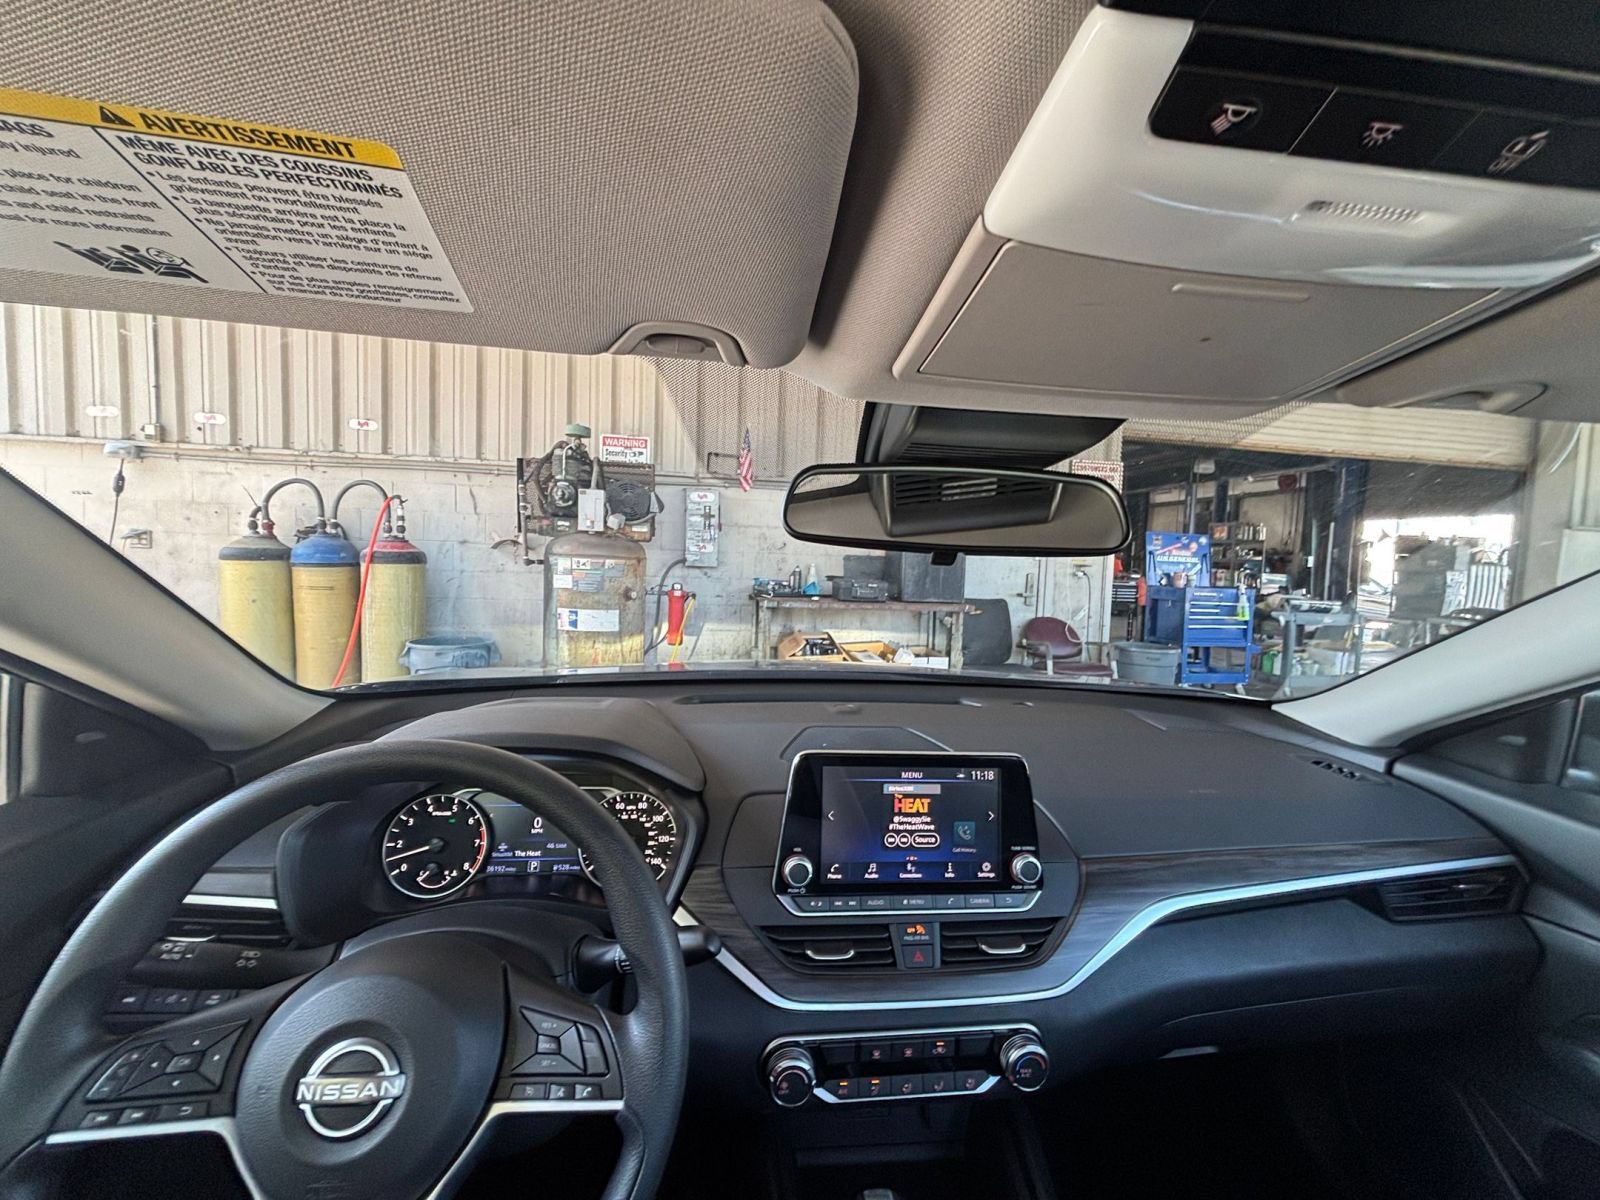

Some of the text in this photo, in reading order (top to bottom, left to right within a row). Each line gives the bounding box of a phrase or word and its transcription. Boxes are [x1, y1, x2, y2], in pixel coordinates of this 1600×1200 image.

[0, 118, 54, 138] AGS
[139, 113, 356, 158] AVERTISSEMENT
[20, 141, 82, 159] injured
[115, 135, 374, 182] MÊME AVEC DES COUSSINS
[133, 152, 403, 198] GONFLABLES PERFECTIONNÉS
[76, 177, 142, 193] children
[159, 171, 383, 209] Les enfants peuvent être blessés
[96, 194, 122, 205] the
[122, 197, 162, 210] front
[169, 184, 360, 216] grièvement ou mortellement
[84, 208, 155, 223] restraints
[193, 207, 396, 238] plus sécuritaire pour les enfants
[201, 199, 272, 215] banquette
[273, 207, 318, 220] arrière
[320, 212, 344, 223] est
[344, 214, 356, 225] la
[357, 218, 392, 230] place
[393, 221, 406, 232] la
[88, 221, 172, 238] information
[226, 220, 271, 234] jamais
[271, 226, 314, 238] mettre
[316, 231, 334, 240] un
[335, 233, 368, 245] siège
[370, 237, 419, 251] d'enfant
[215, 227, 283, 242] orientation
[283, 234, 313, 245] vers
[362, 244, 382, 253] sur
[383, 248, 400, 256] un
[402, 248, 433, 260] siège
[224, 236, 260, 247] avant
[288, 252, 328, 264] utiliser
[330, 256, 349, 265] les
[350, 260, 402, 272] ceintures
[404, 264, 418, 273] de
[604, 437, 646, 448] WARNING
[605, 448, 628, 459] Security
[901, 770, 995, 780] MENU 11:18
[427, 805, 434, 813] 4
[452, 804, 458, 812] 5
[894, 798, 931, 813] HEAT
[407, 818, 414, 826] 3
[468, 817, 474, 825] 6
[533, 817, 542, 828] 0
[396, 840, 403, 848] 2
[474, 839, 480, 847] 7
[400, 863, 407, 871] 0
[296, 1079, 400, 1101] NISSAN
